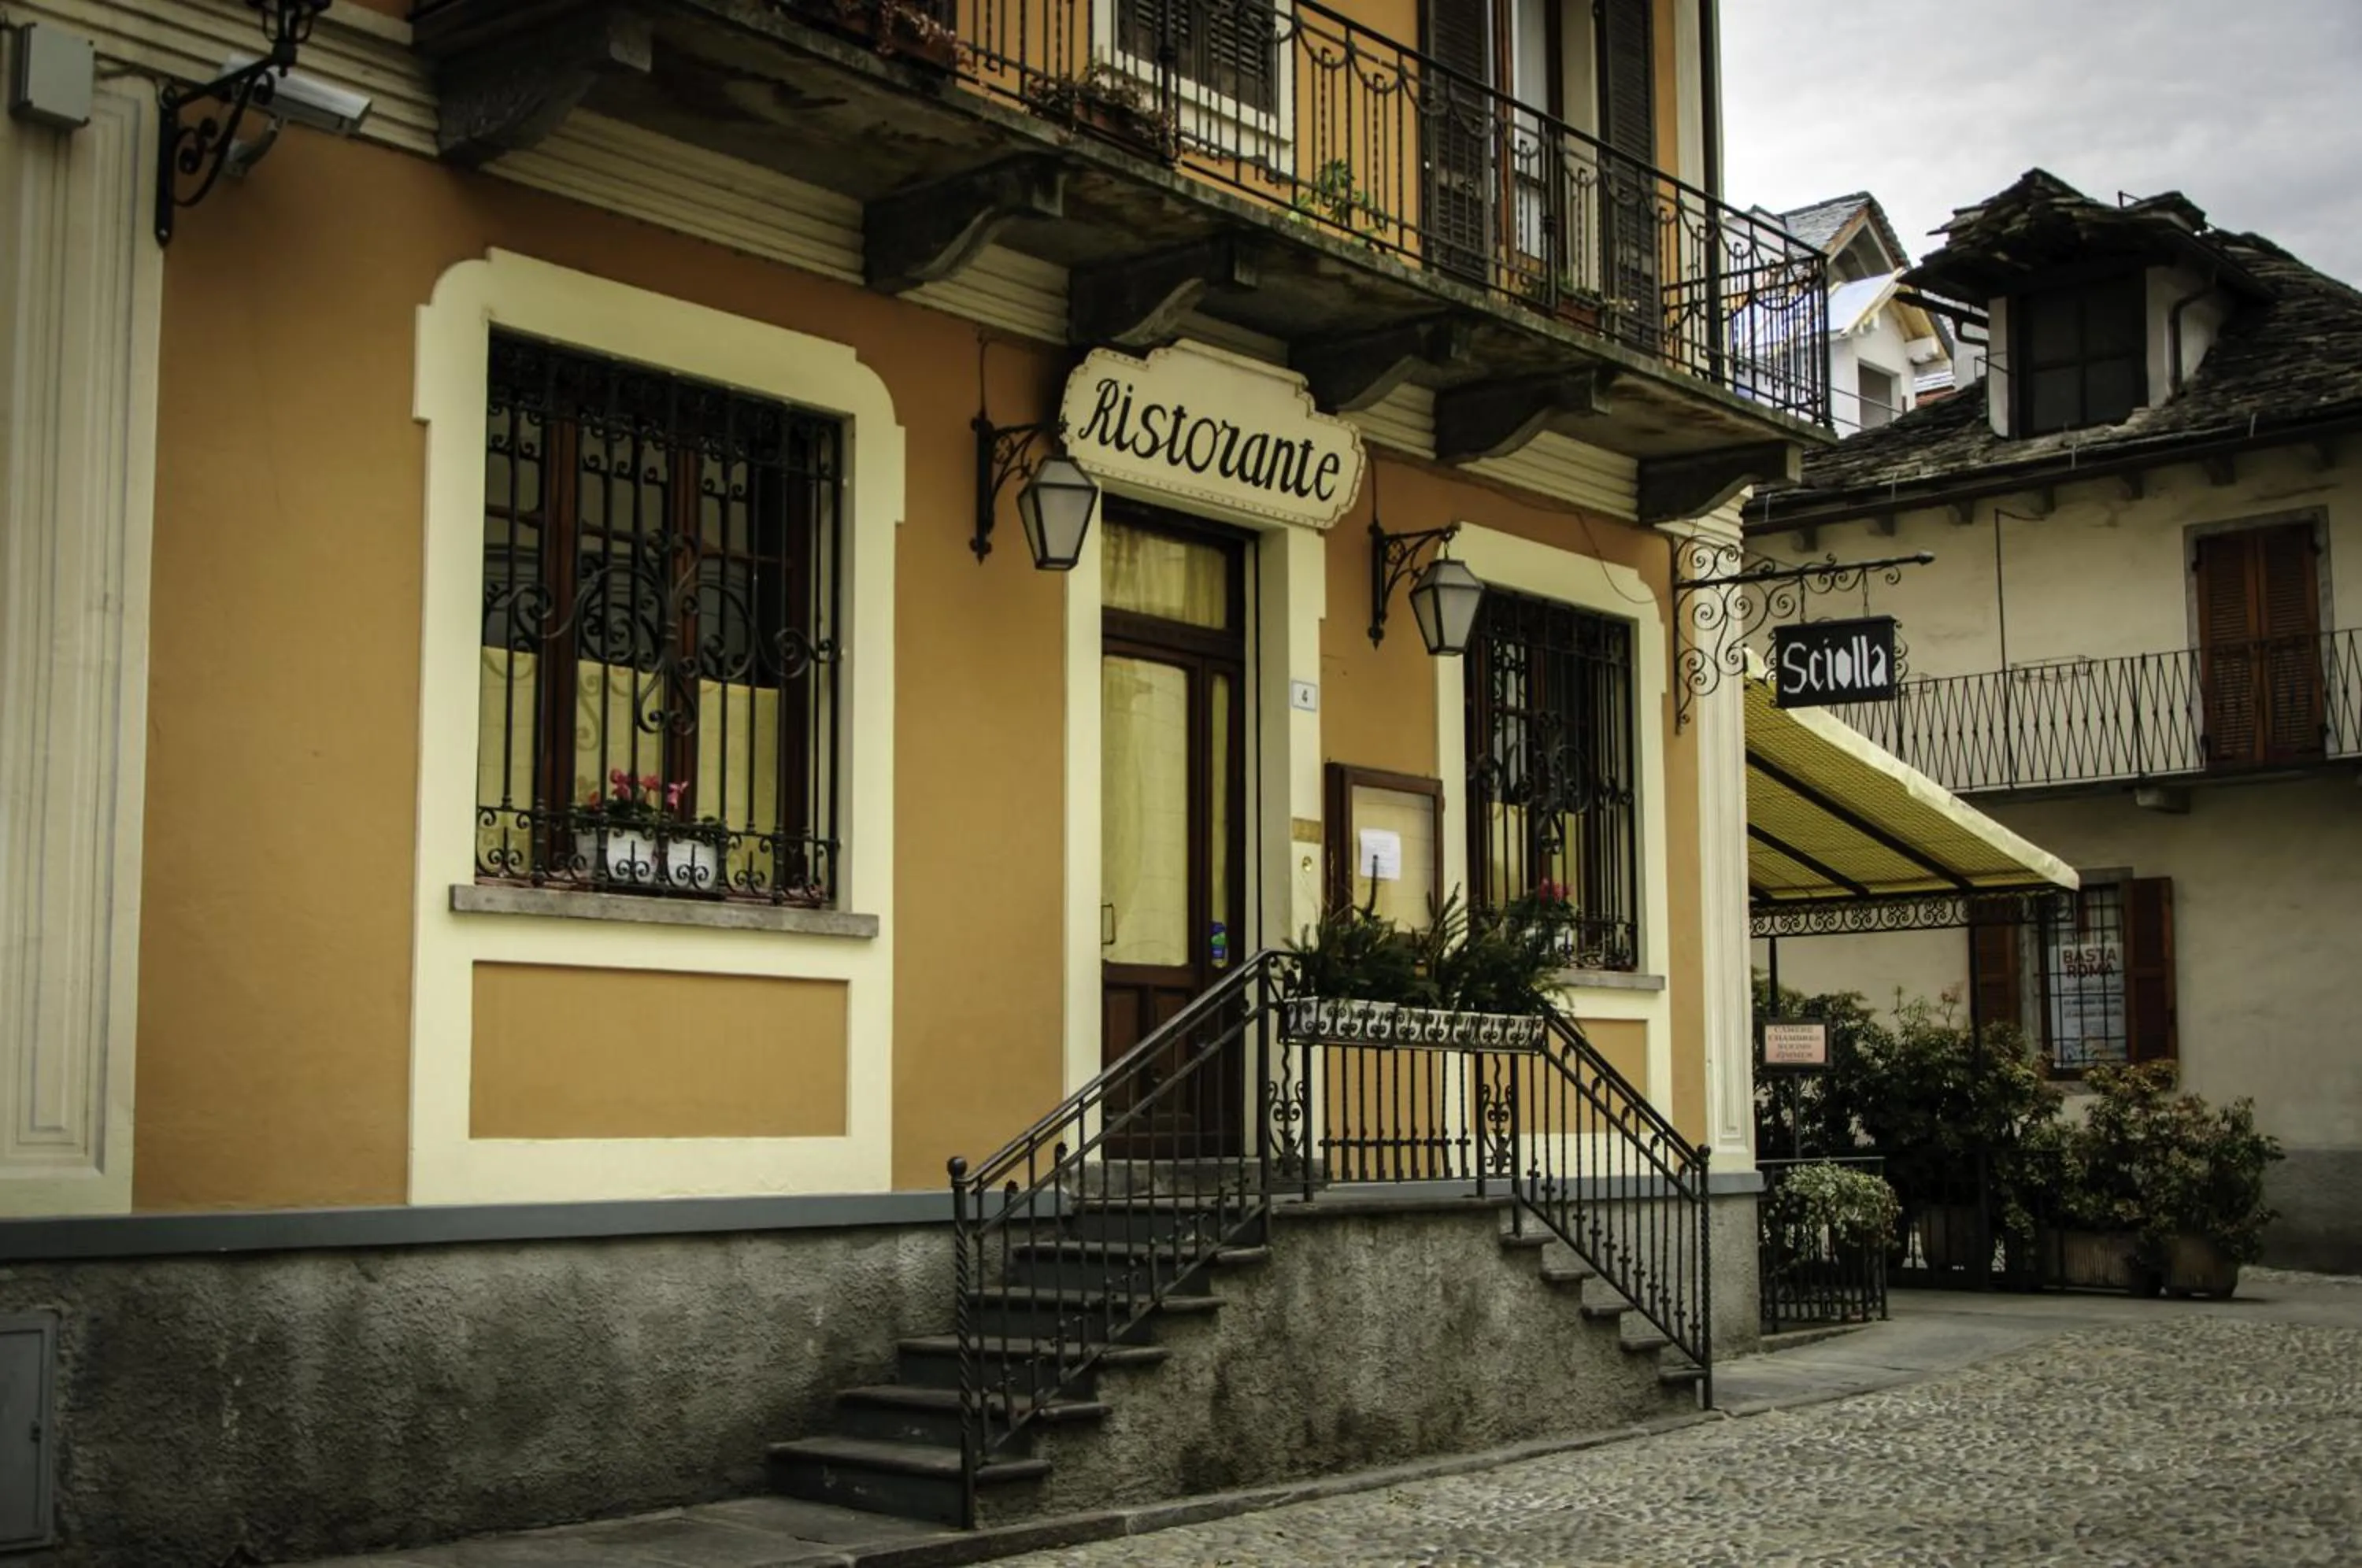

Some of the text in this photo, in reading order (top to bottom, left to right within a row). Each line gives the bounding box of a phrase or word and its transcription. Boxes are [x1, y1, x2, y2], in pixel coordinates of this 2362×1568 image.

[1079, 378, 1340, 501] Ristorante
[1783, 634, 1888, 693] Sciolla
[2063, 947, 2117, 964] BASTA
[2066, 963, 2116, 978] ROMA
